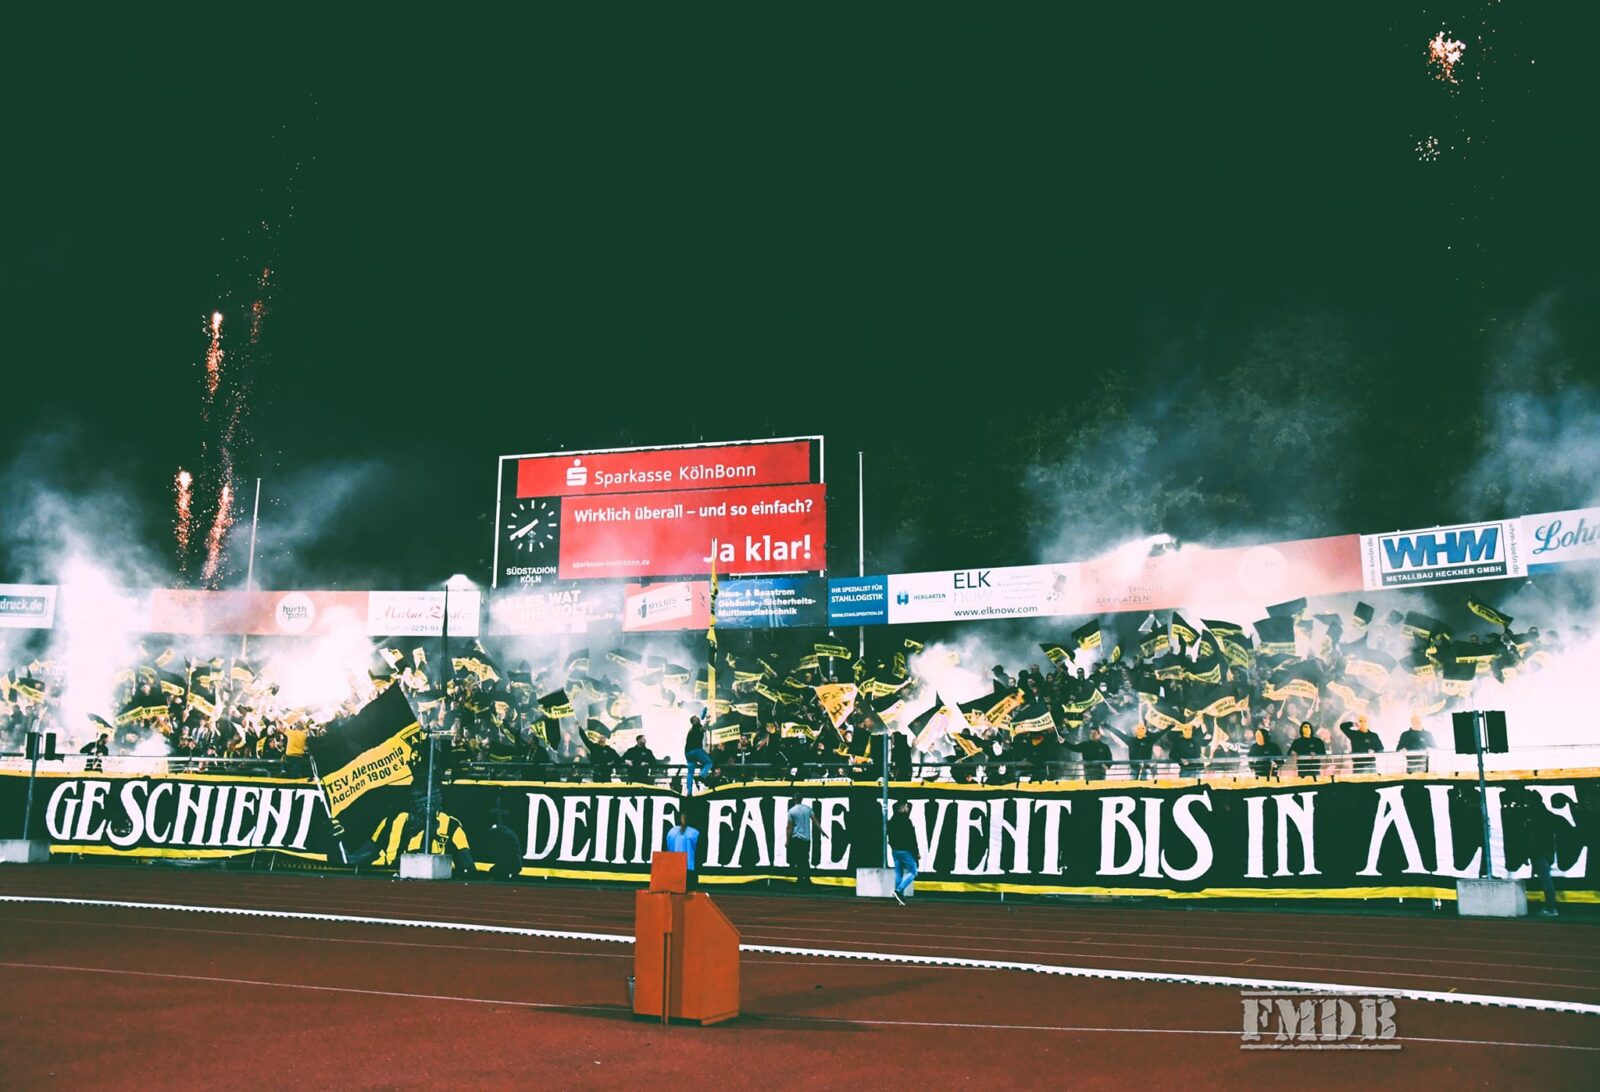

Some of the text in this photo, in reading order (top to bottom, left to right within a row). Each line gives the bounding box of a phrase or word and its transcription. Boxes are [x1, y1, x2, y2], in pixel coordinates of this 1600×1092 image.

[594, 468, 672, 488] Sparkasse
[679, 464, 757, 480] KölnBonn
[574, 507, 631, 523] Wirklich
[635, 504, 683, 520] überall
[699, 502, 727, 517] und
[730, 504, 748, 516] so
[751, 499, 813, 516] einfach?
[703, 534, 812, 563] Ja klar!
[1382, 527, 1499, 570] WHM
[506, 566, 557, 576] SÜDSTADION
[1386, 565, 1502, 583] METALLBAU HECKNER GMBH
[520, 575, 542, 584] KÖLN
[953, 570, 991, 589] ELK
[548, 589, 581, 605] WAT
[718, 590, 743, 598] Haus-
[753, 588, 795, 597] Baustrom
[842, 585, 871, 593] SPEZIALIST
[913, 592, 946, 601] HERGARTEN
[763, 597, 816, 606] Sicherheits-
[831, 593, 884, 603] STAHLLOGISTIK
[717, 607, 797, 617] Multimediatechnik
[954, 605, 1038, 617] www.elknow.com
[327, 775, 349, 794] TSV
[351, 746, 404, 781] Alemannia
[332, 780, 366, 805] Aachen
[367, 767, 391, 783] 1900
[1096, 790, 1214, 882] BIS
[1243, 791, 1323, 879] IN
[1355, 784, 1588, 879] ALLE
